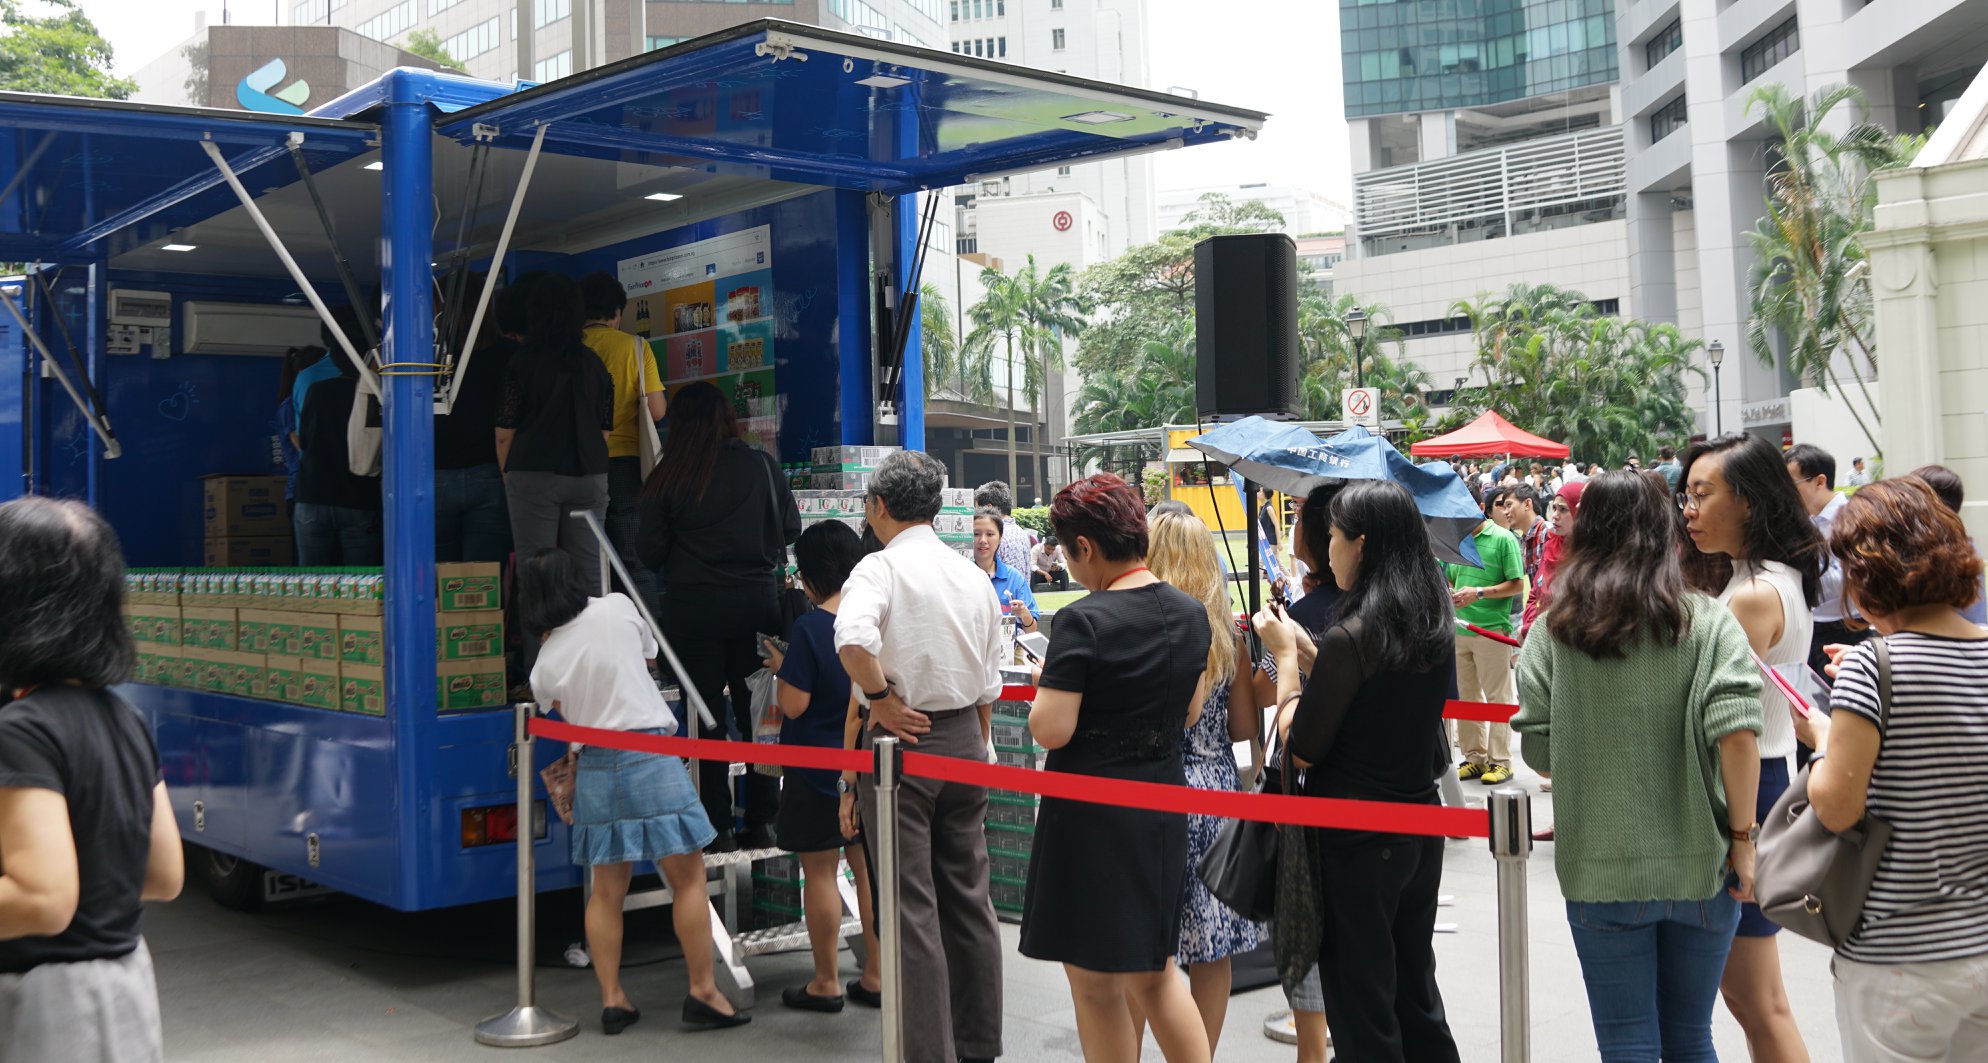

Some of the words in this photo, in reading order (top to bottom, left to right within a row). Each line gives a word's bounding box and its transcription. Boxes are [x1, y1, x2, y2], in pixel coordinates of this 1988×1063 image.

[1286, 446, 1351, 468] 中国工商银行
